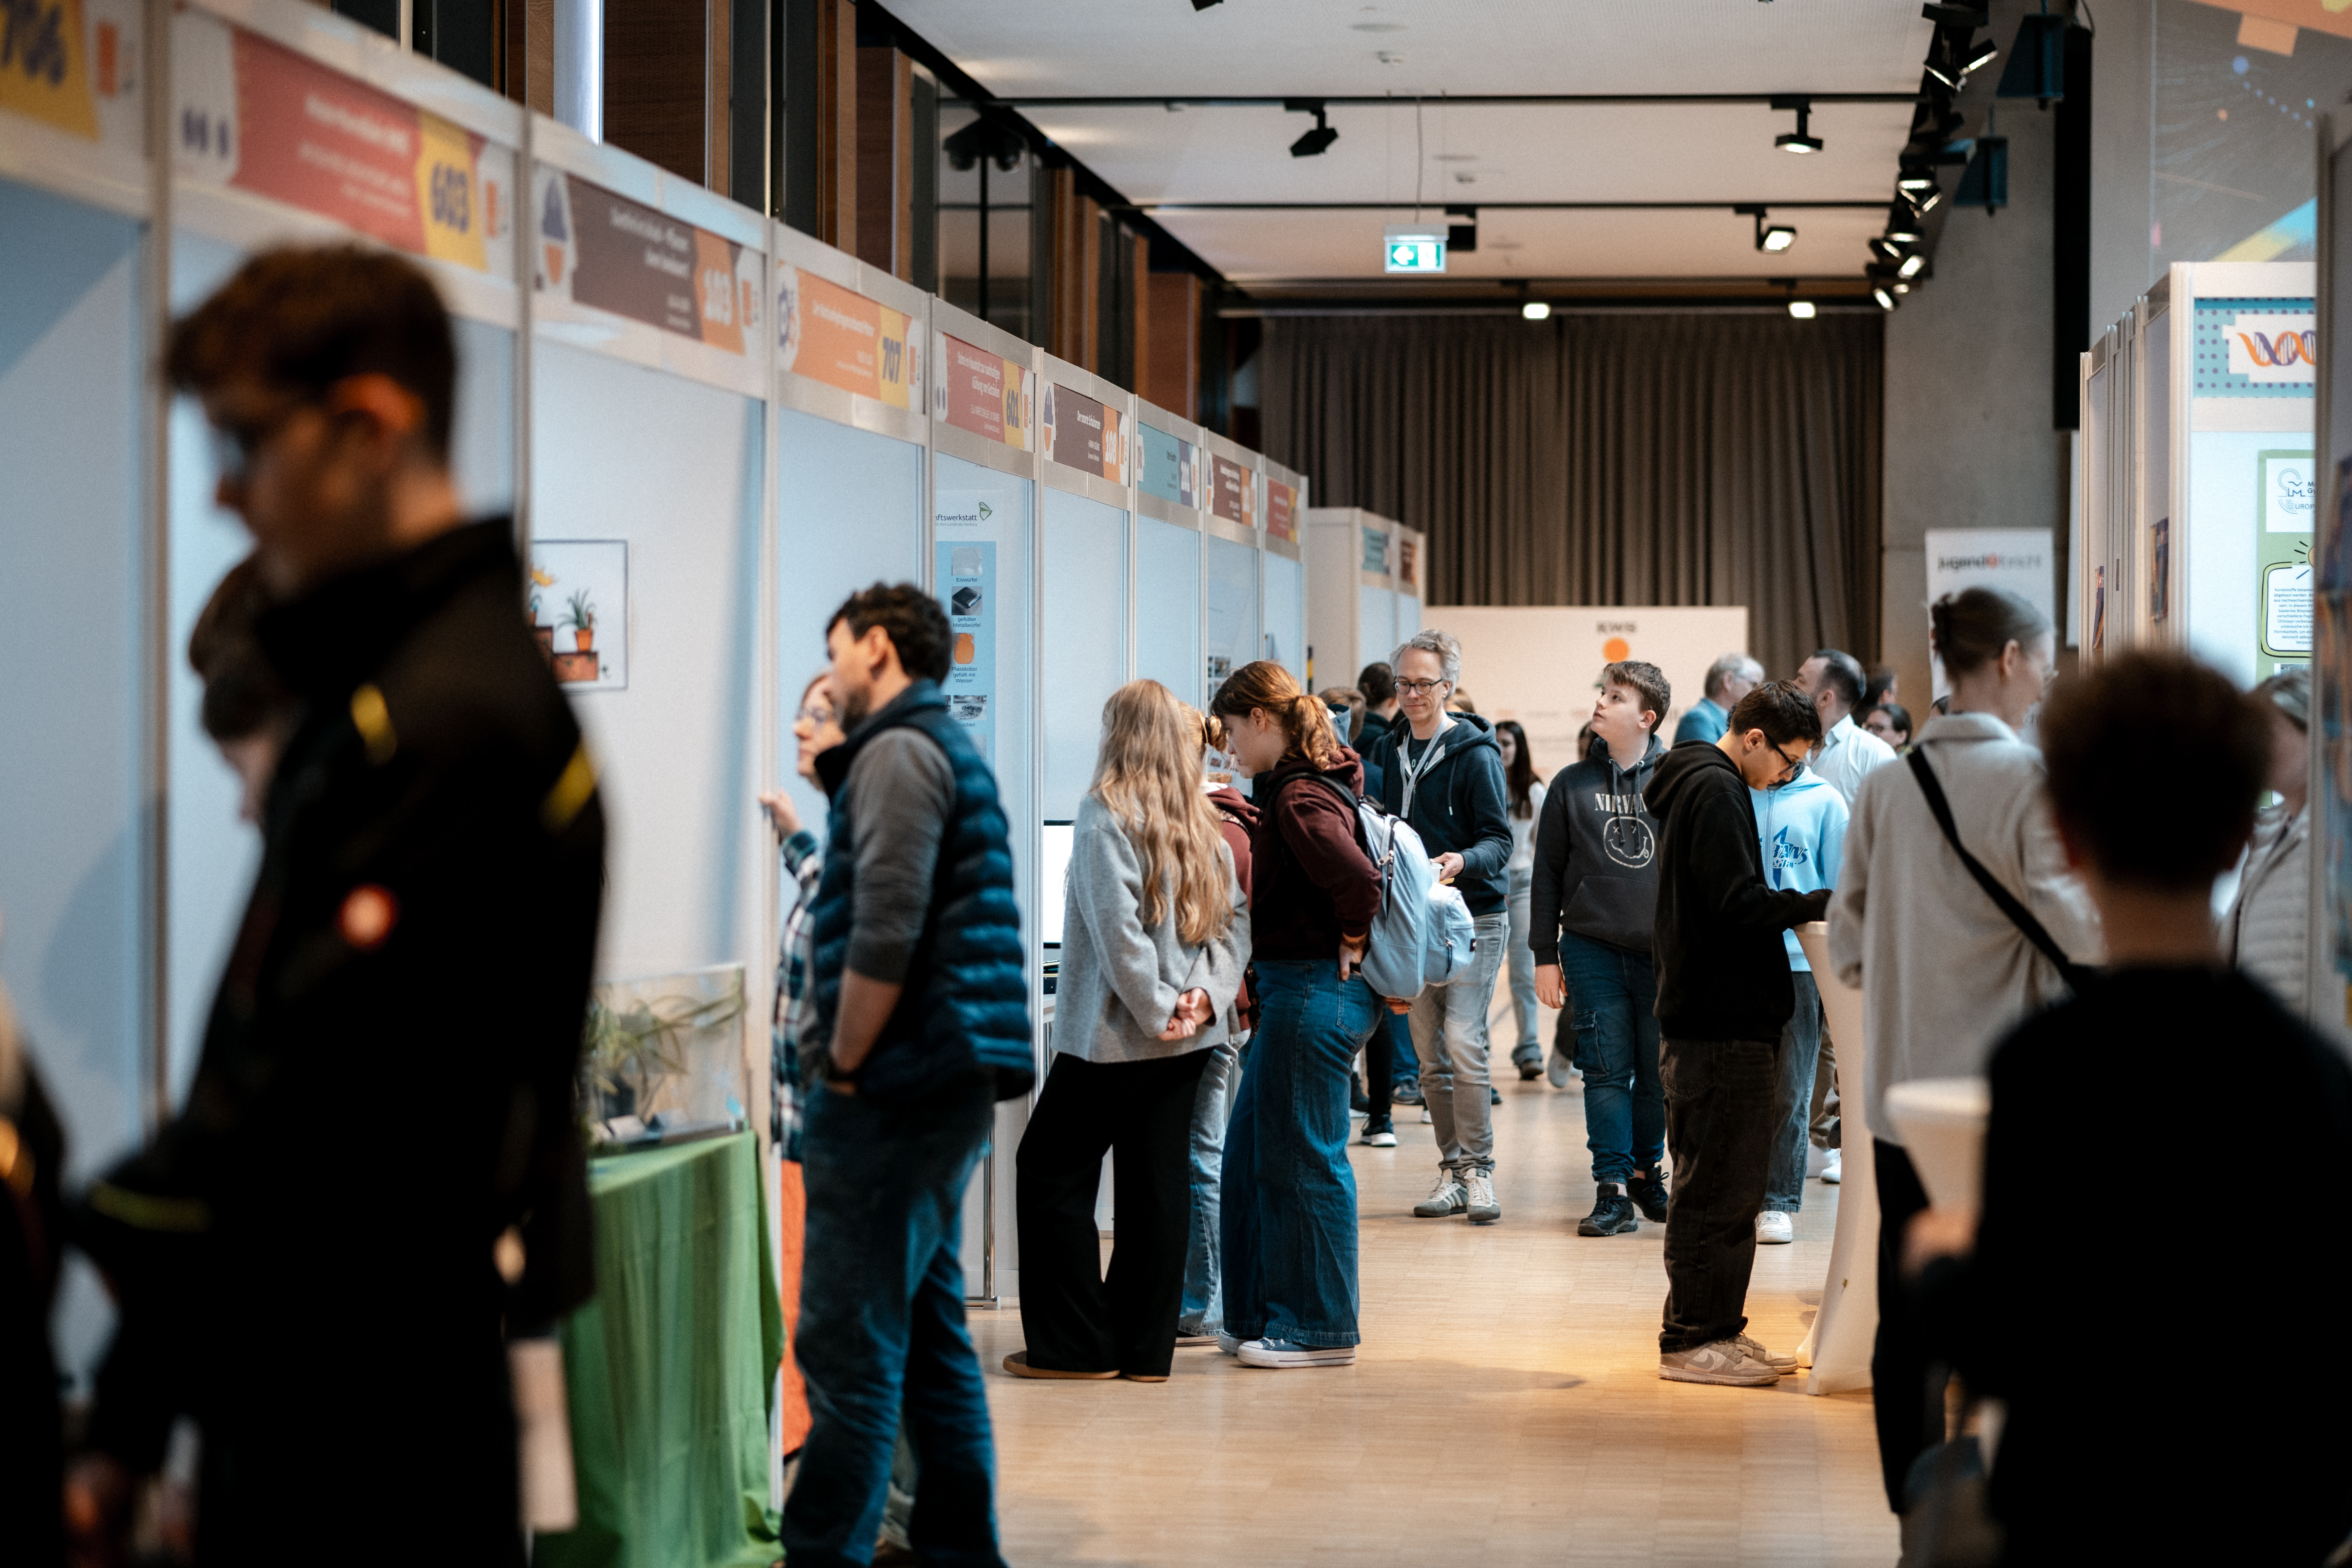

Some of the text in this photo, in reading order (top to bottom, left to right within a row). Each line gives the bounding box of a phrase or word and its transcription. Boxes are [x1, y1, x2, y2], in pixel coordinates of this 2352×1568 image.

[430, 161, 469, 233] 603
[882, 336, 901, 384] 707
[1006, 388, 1019, 429] 601
[1105, 429, 1117, 465] 108
[1773, 859, 1798, 868] Star
